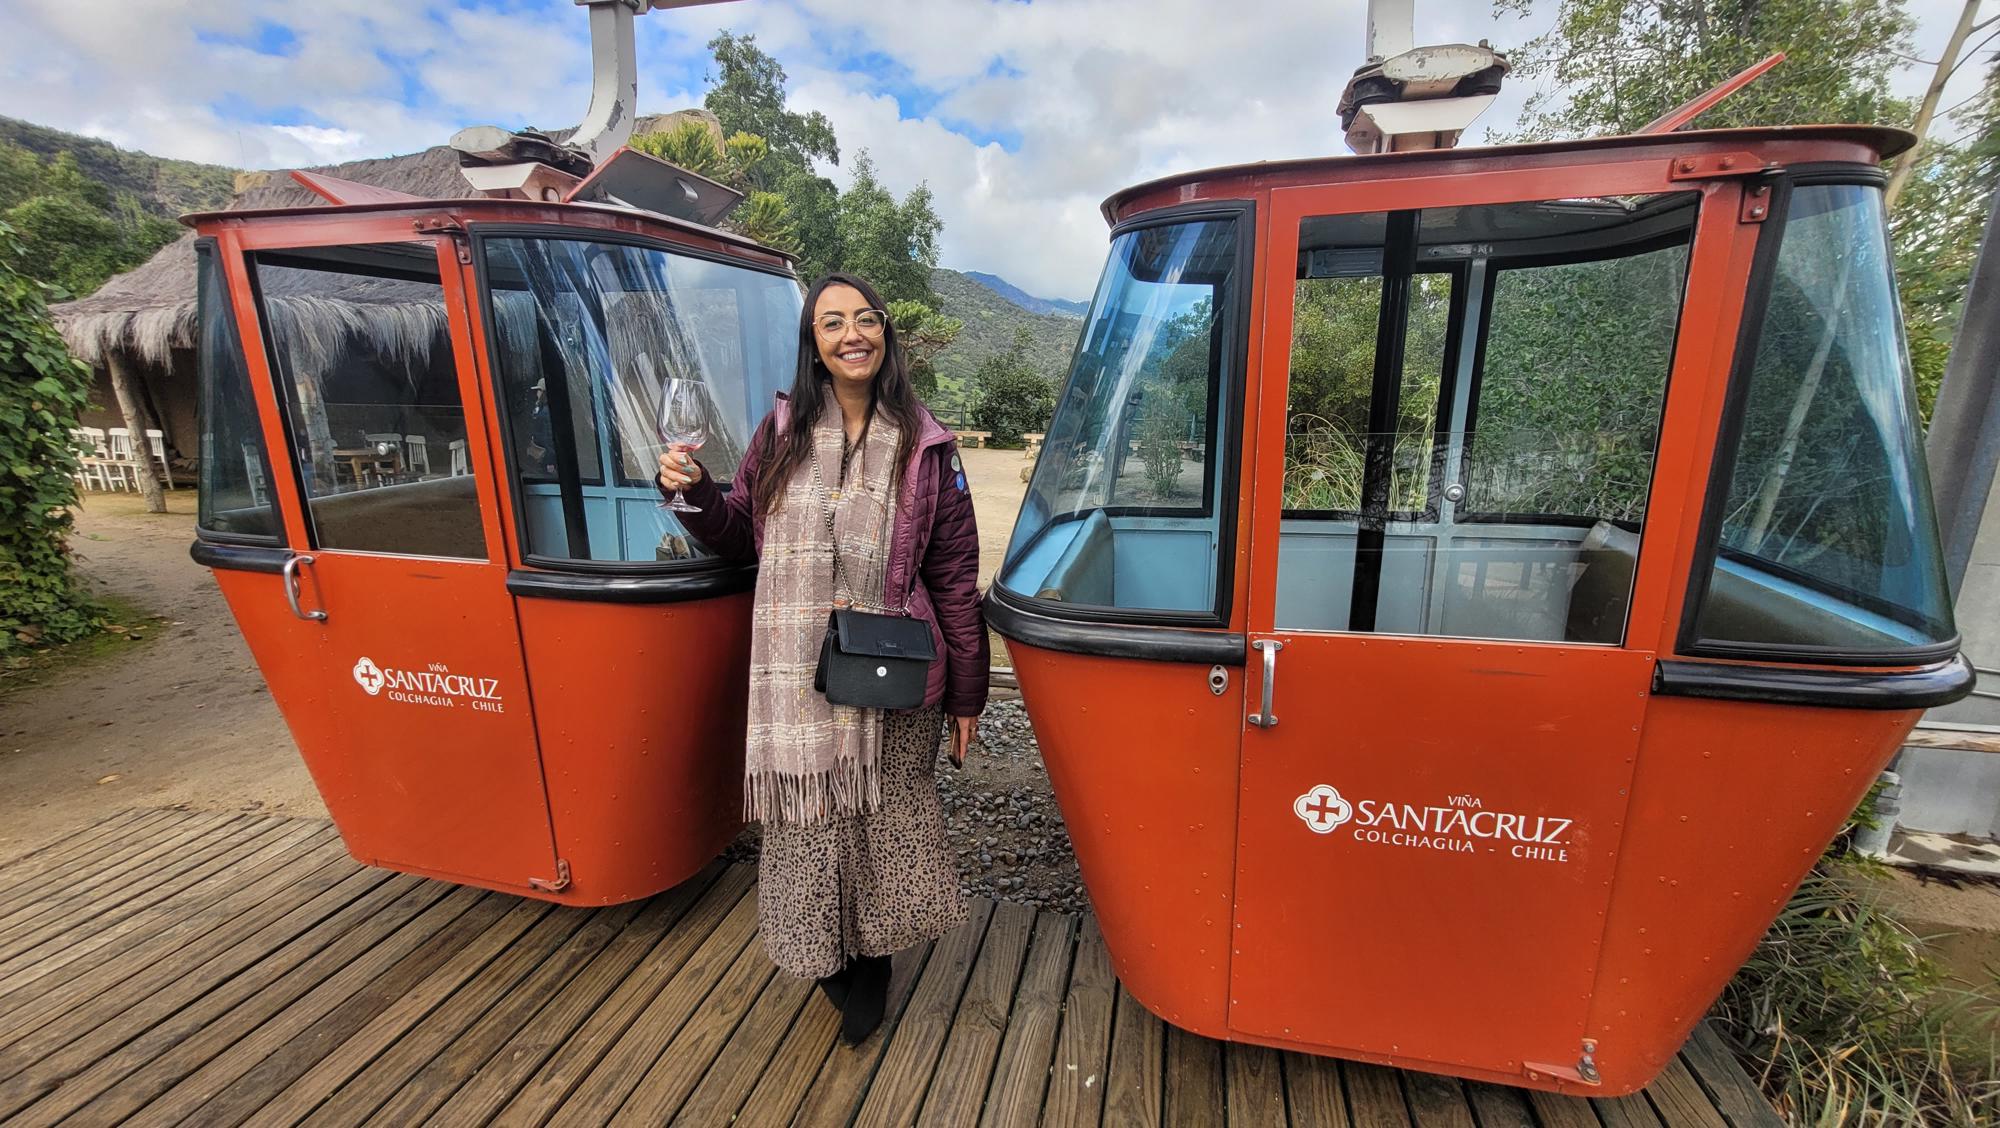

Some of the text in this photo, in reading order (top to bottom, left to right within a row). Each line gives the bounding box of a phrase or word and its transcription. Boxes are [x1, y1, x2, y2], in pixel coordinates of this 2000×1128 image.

[472, 700, 504, 713] CHILE
[1447, 794, 1482, 809] VIÑA
[1511, 845, 1568, 862] CHILE
